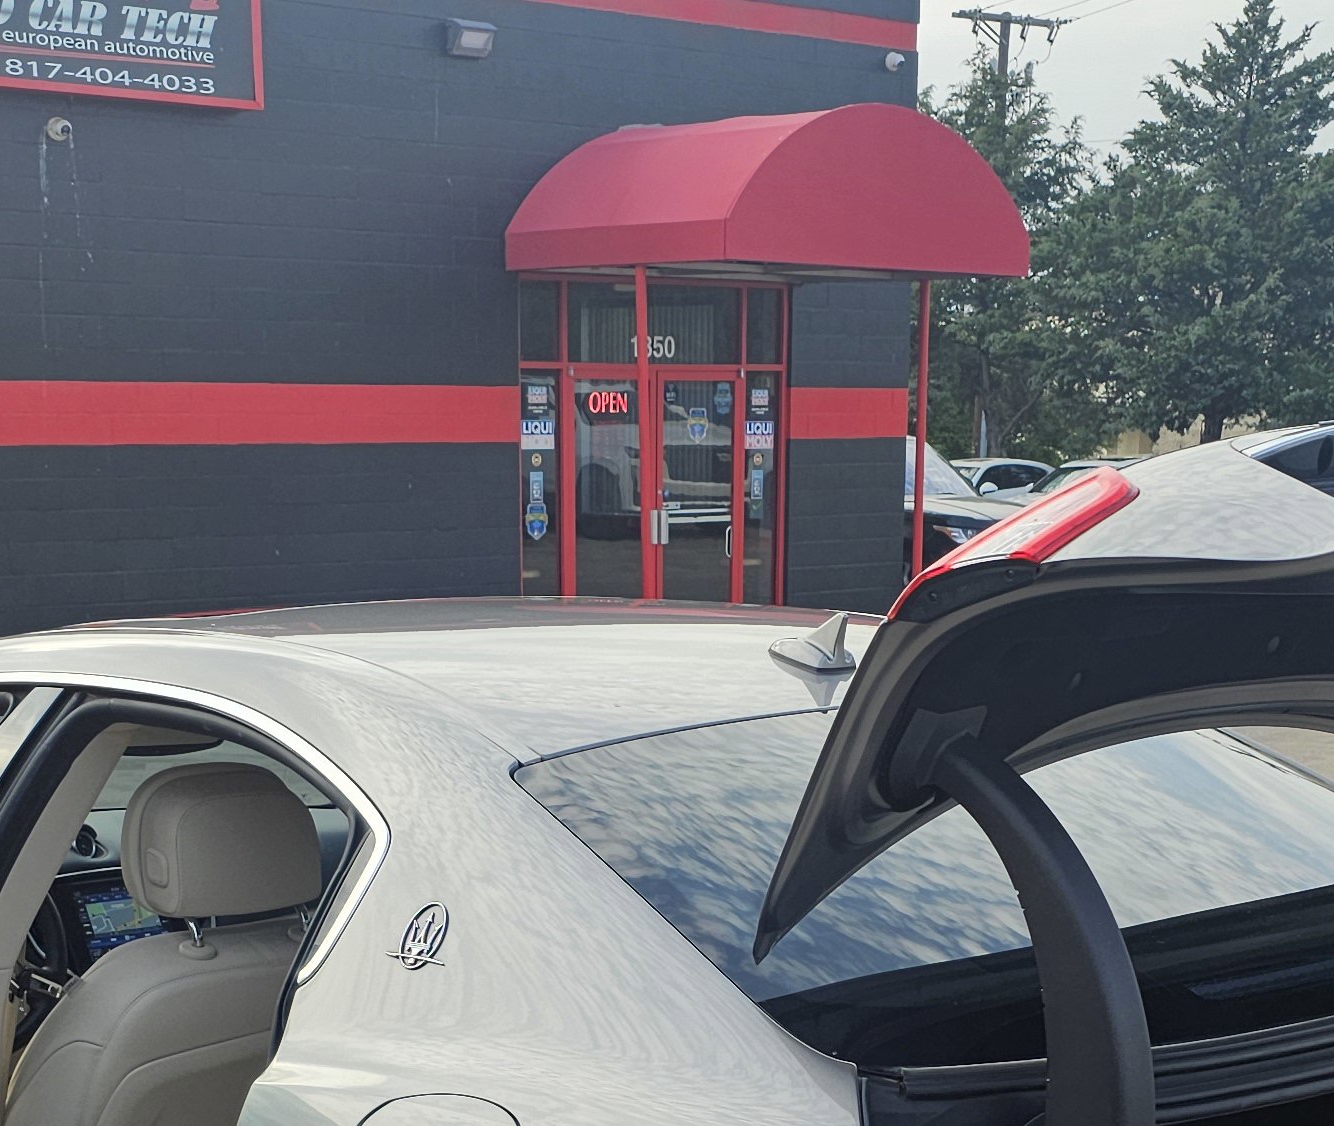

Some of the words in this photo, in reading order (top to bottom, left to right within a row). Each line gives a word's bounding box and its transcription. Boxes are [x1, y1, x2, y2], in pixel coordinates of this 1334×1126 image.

[28, 0, 108, 36] CAR
[120, 5, 218, 48] TECH
[2, 30, 98, 51] european
[104, 40, 214, 63] automotive
[5, 58, 216, 94] 817-404-4033
[588, 391, 627, 413] OPEN
[522, 421, 553, 434] LIQUI
[746, 422, 773, 434] LIQUI
